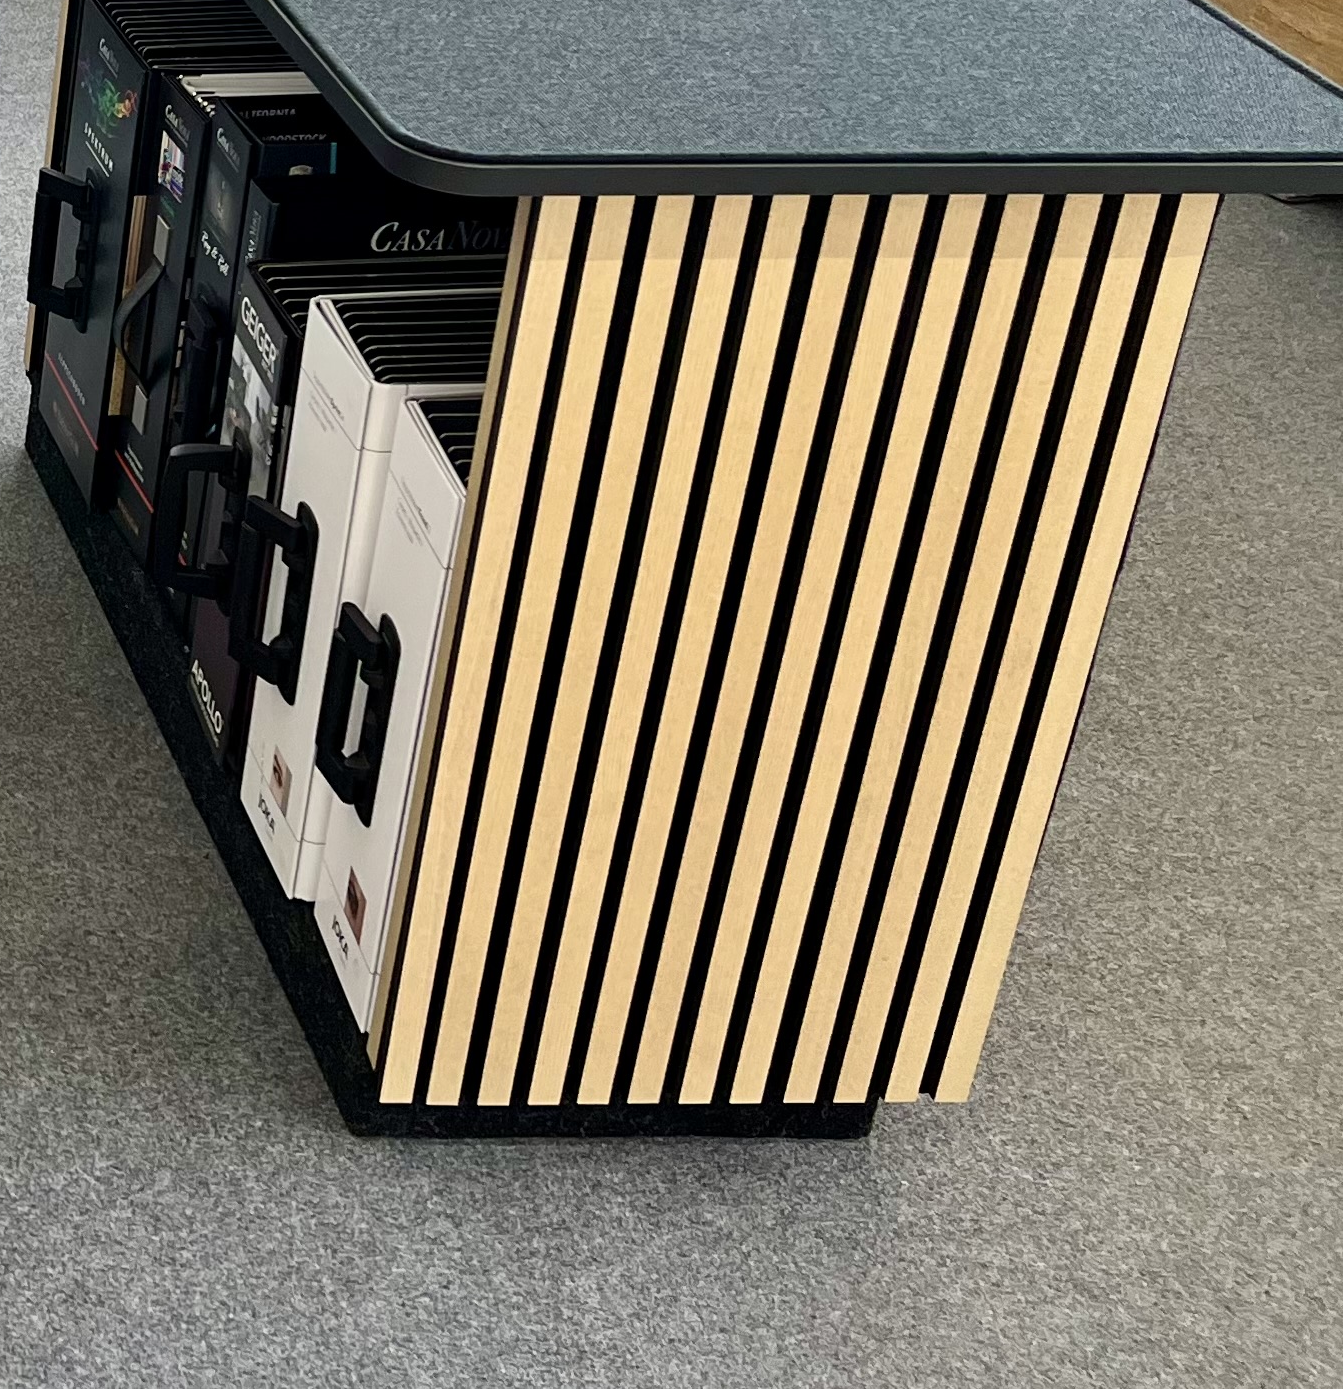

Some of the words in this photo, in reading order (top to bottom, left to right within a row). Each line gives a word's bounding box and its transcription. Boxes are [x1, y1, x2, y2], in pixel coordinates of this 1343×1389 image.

[370, 221, 445, 253] CASA
[447, 220, 510, 251] NOV
[241, 296, 277, 374] GEIGER
[191, 659, 224, 735] APOLLO
